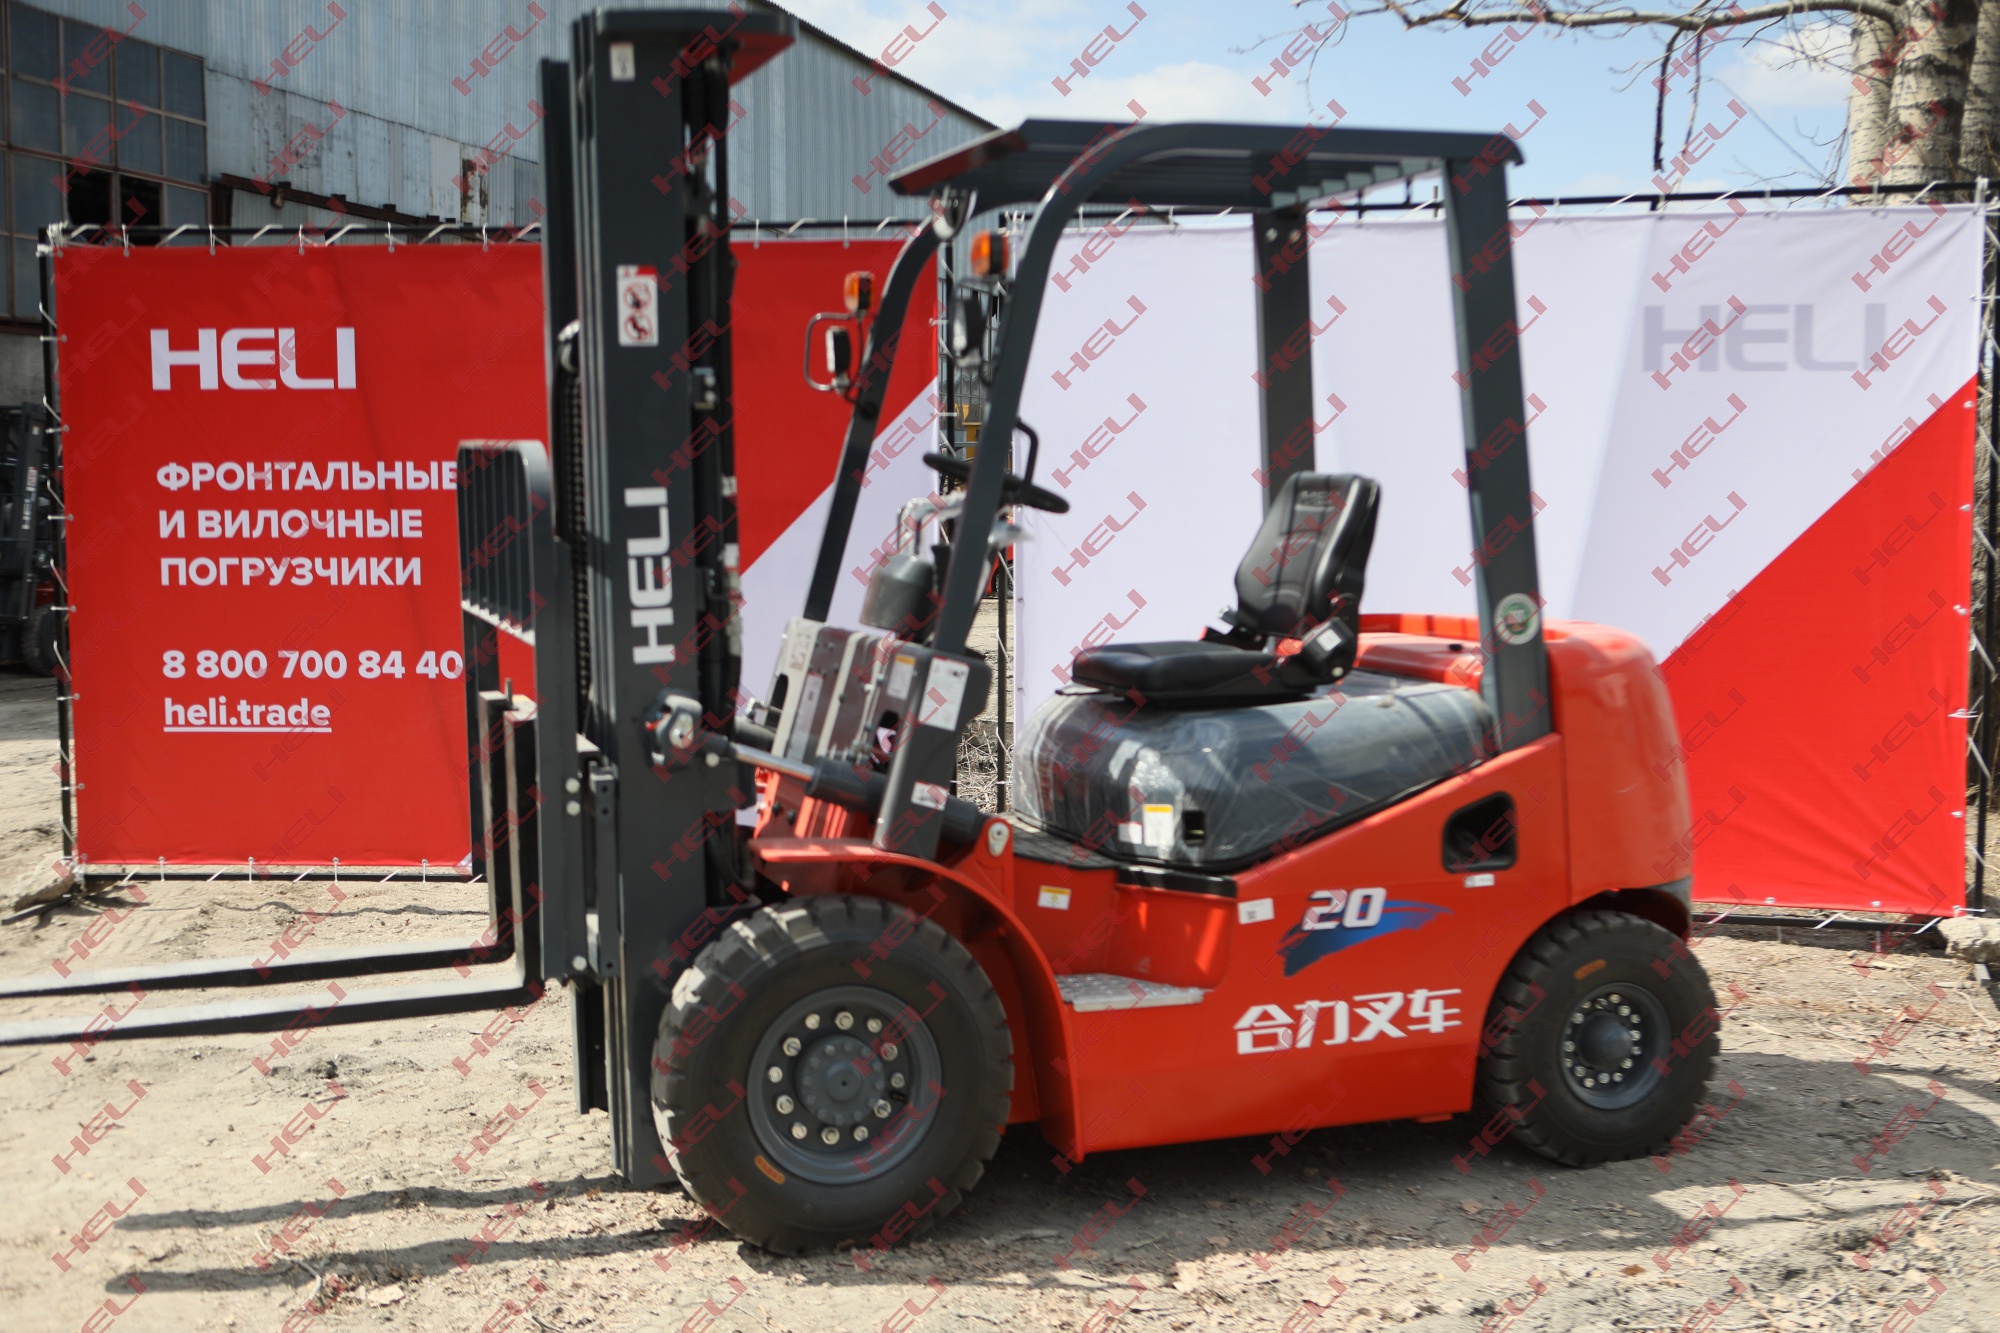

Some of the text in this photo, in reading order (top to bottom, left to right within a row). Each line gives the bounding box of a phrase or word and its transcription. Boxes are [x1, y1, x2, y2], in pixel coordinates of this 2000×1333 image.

[1643, 303, 1887, 372] HELI
[150, 327, 356, 390] HELI
[157, 461, 458, 491] ФРОНТАЛЬНЫЕ
[159, 509, 423, 538] И ВИЛОЧНЫЕ
[161, 557, 422, 586] ПОГРУЗЧИКИ
[624, 487, 676, 664] HELI
[162, 649, 464, 679] 8 800 700 84 40
[164, 695, 331, 727] heli.trade
[1302, 886, 1387, 931] 20
[1233, 988, 1463, 1056] 合力叉车
